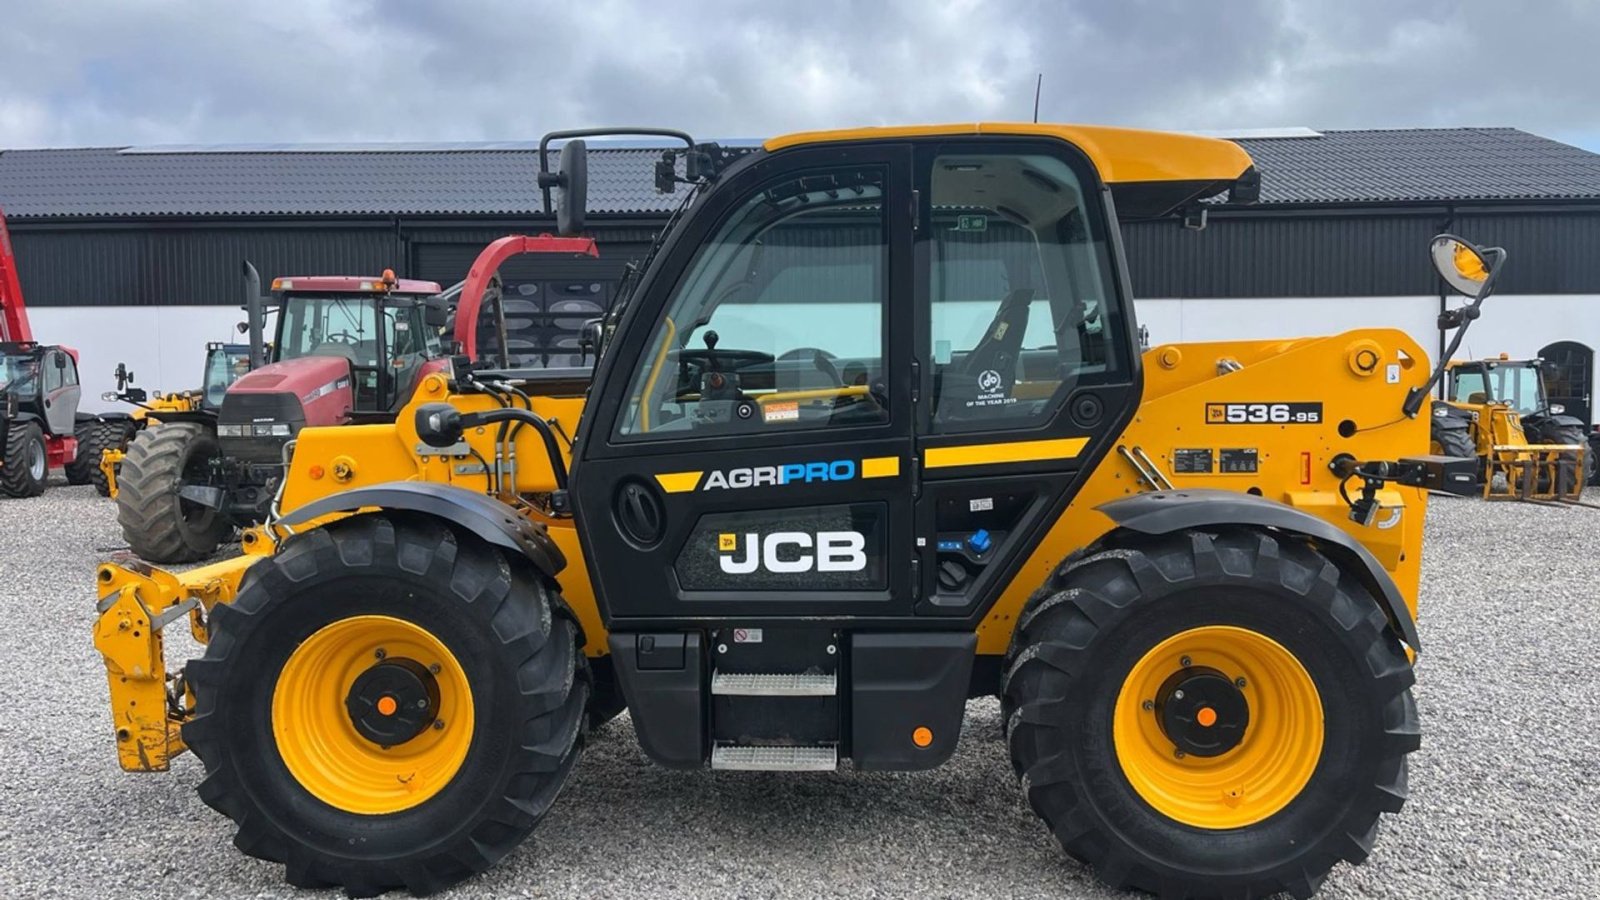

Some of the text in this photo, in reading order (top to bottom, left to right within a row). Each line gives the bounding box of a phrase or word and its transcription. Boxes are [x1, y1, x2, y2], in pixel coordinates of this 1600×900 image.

[1227, 404, 1319, 423] 536-95
[703, 460, 855, 491] AGRIPRO
[719, 531, 867, 574] JCB
